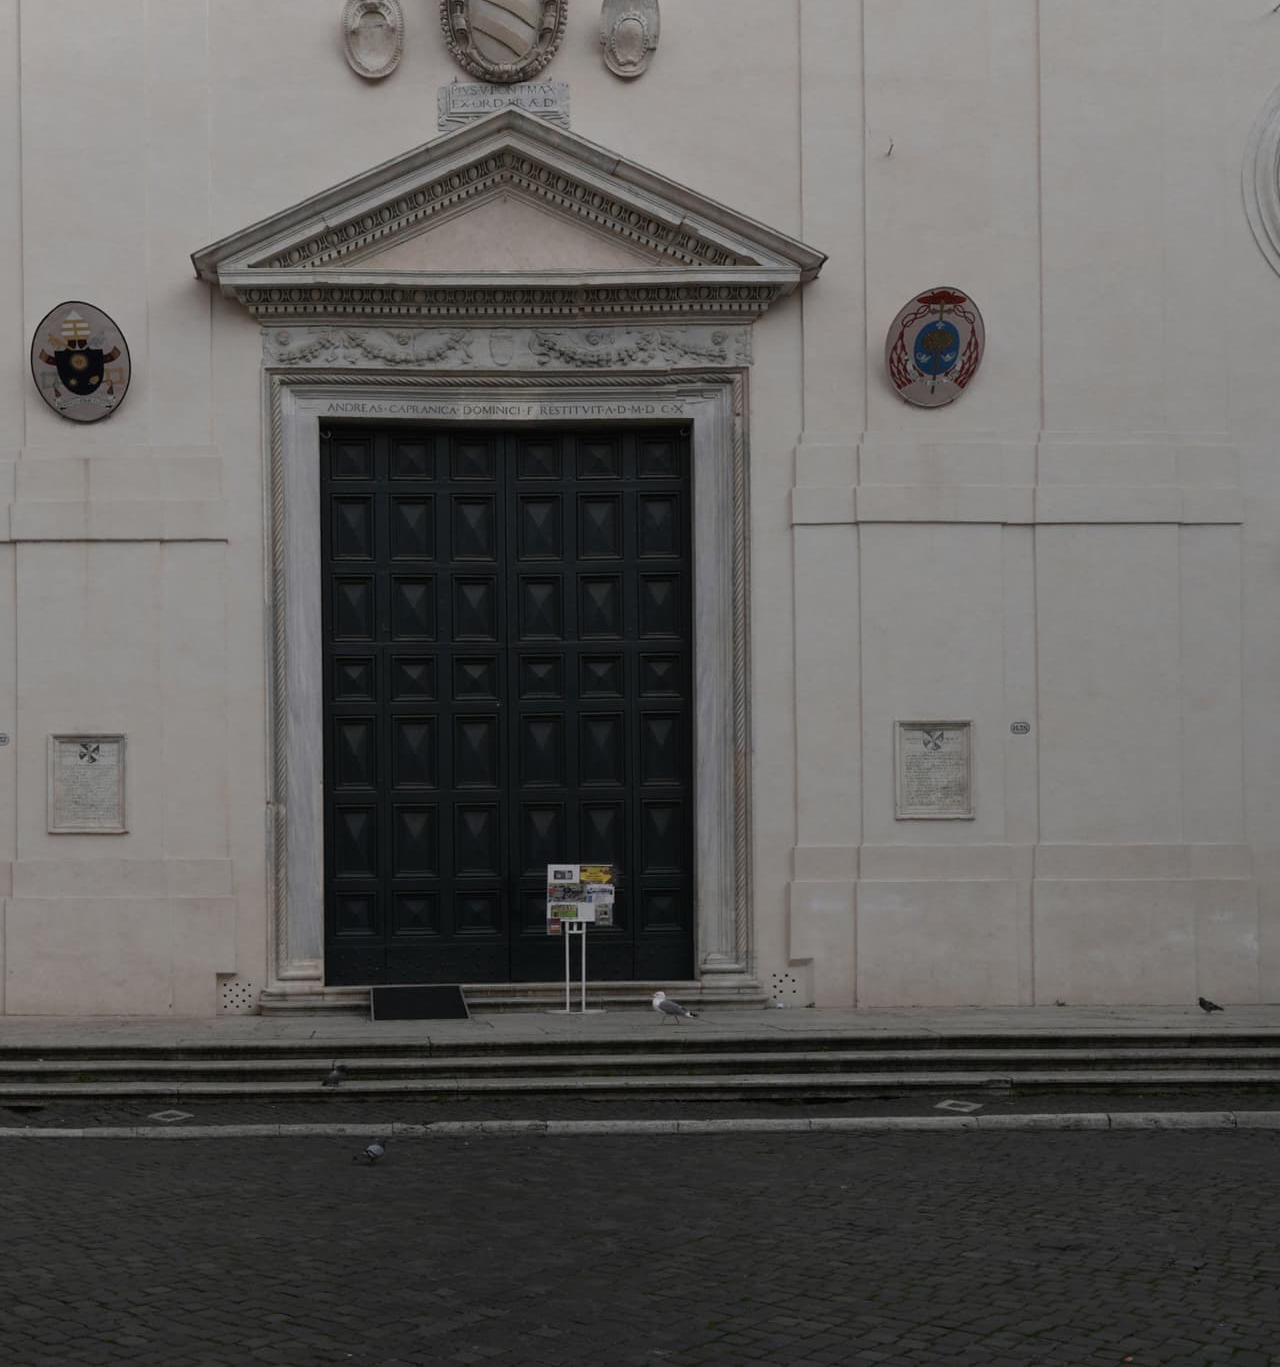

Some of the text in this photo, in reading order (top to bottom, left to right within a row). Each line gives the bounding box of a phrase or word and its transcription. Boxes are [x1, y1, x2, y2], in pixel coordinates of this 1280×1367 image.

[327, 402, 384, 413] ANDREAS
[388, 404, 457, 415] CAPRANICA
[462, 405, 521, 416] DOMINICI
